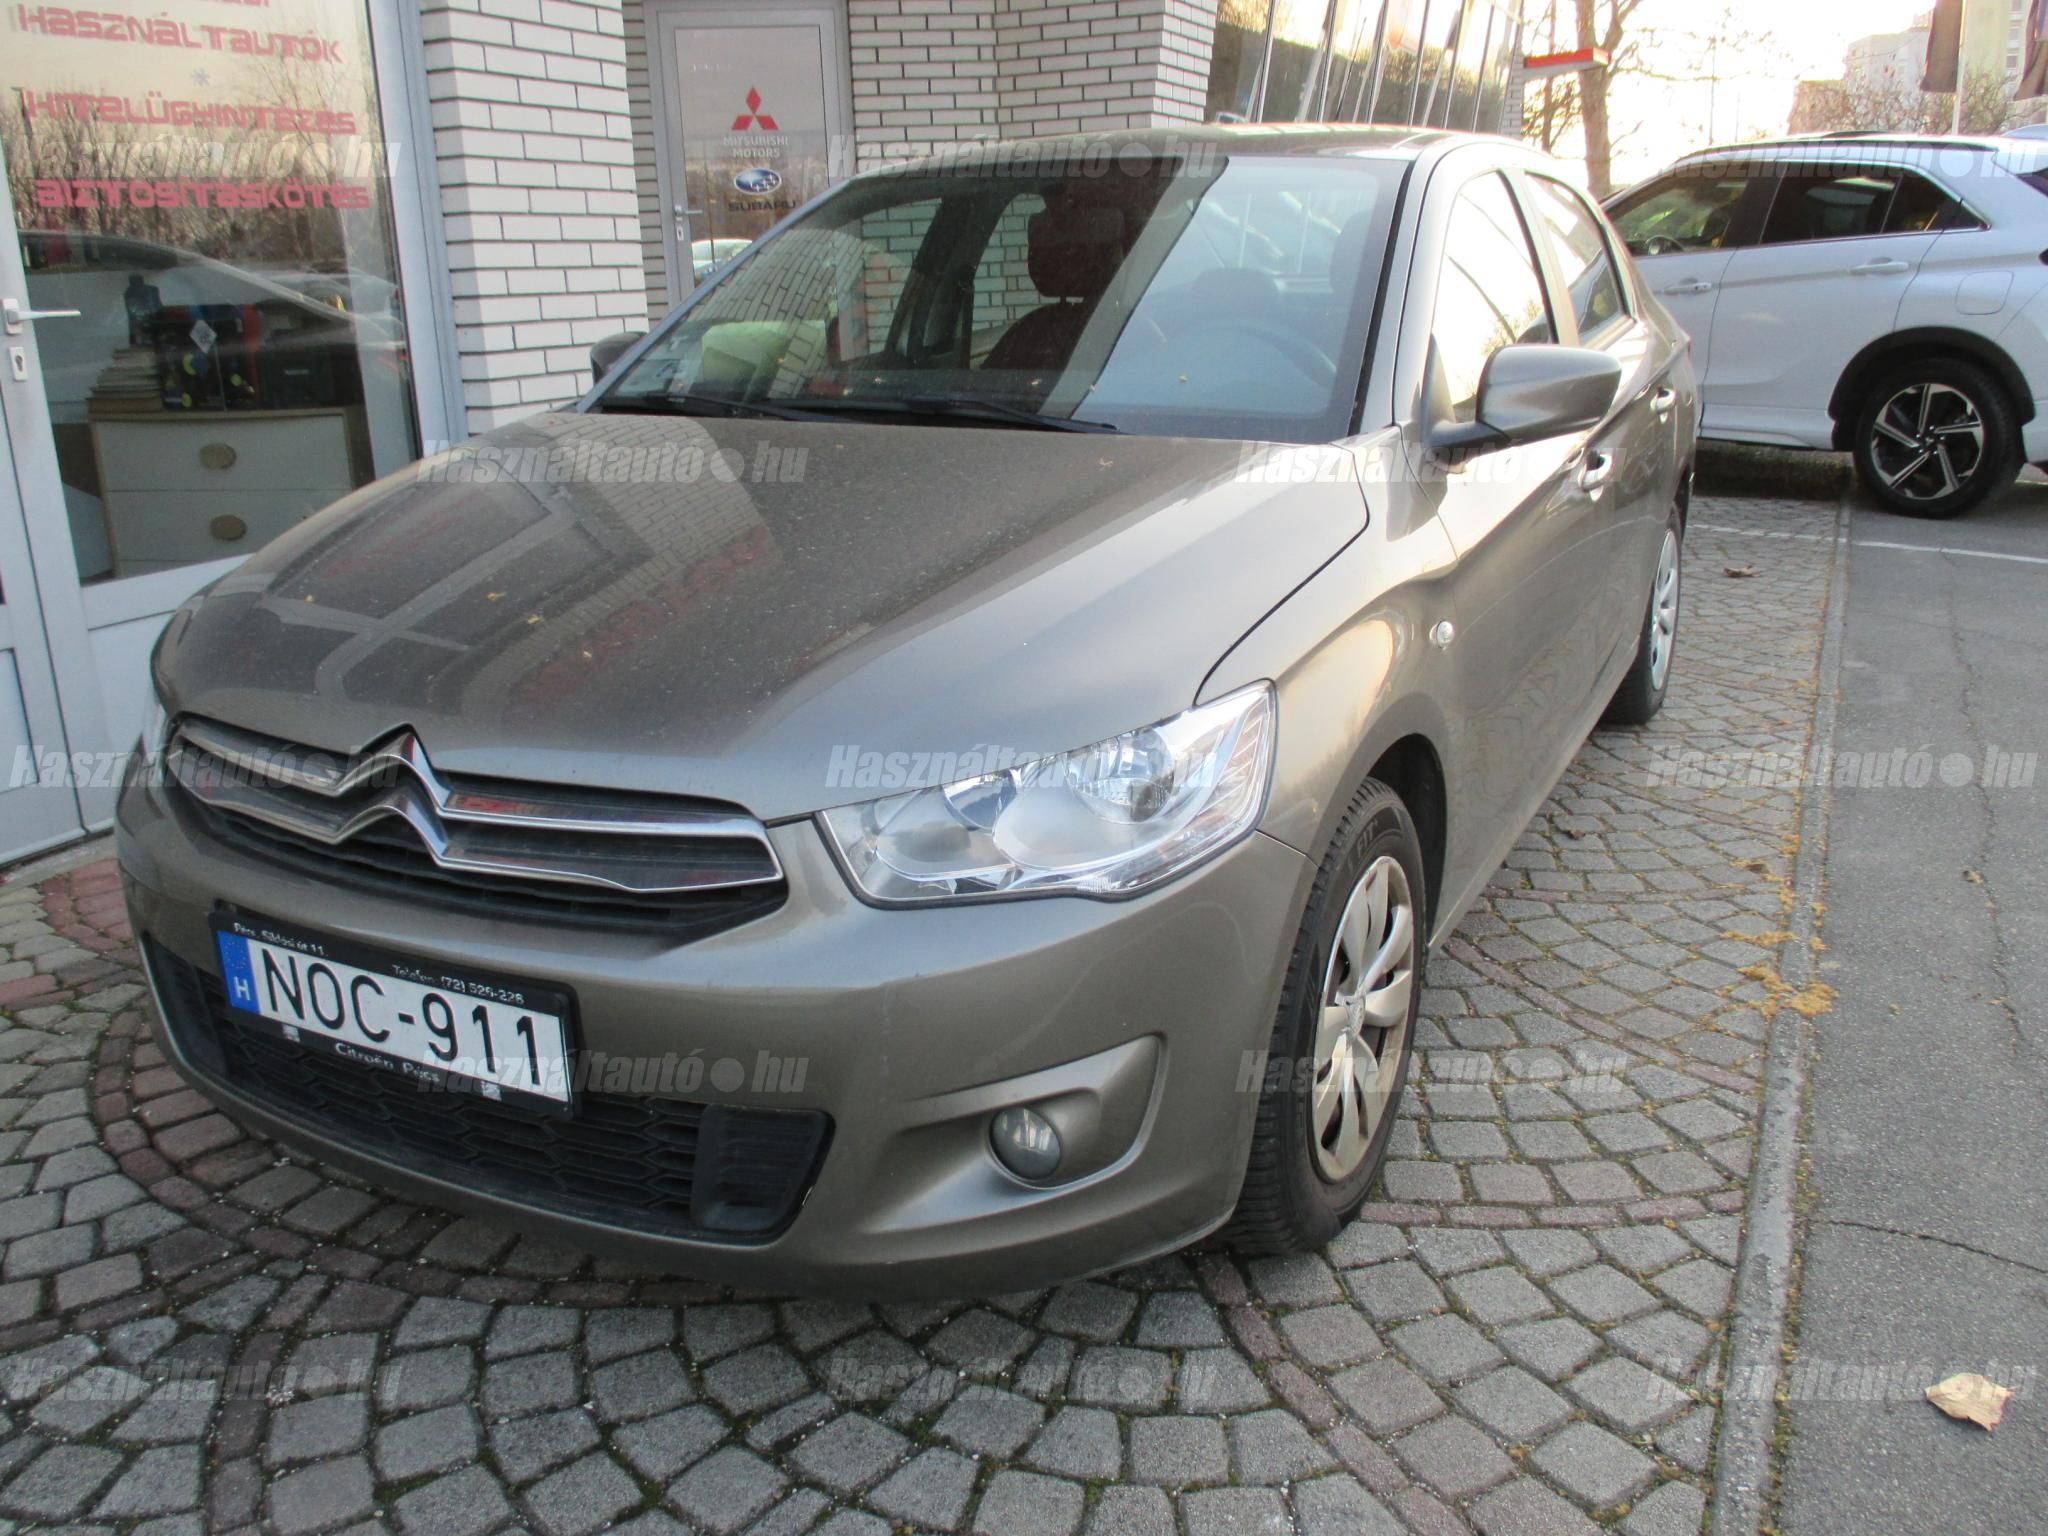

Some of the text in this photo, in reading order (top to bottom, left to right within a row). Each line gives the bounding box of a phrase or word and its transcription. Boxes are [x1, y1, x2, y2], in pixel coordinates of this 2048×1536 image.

[722, 135, 790, 147] MITSUBISHI
[732, 147, 781, 159] MOTORS
[728, 200, 796, 212] SUBARU
[234, 975, 251, 1001] H
[440, 975, 466, 994] (72)
[261, 947, 541, 1086] NOC-911
[334, 1041, 394, 1071] Citroën
